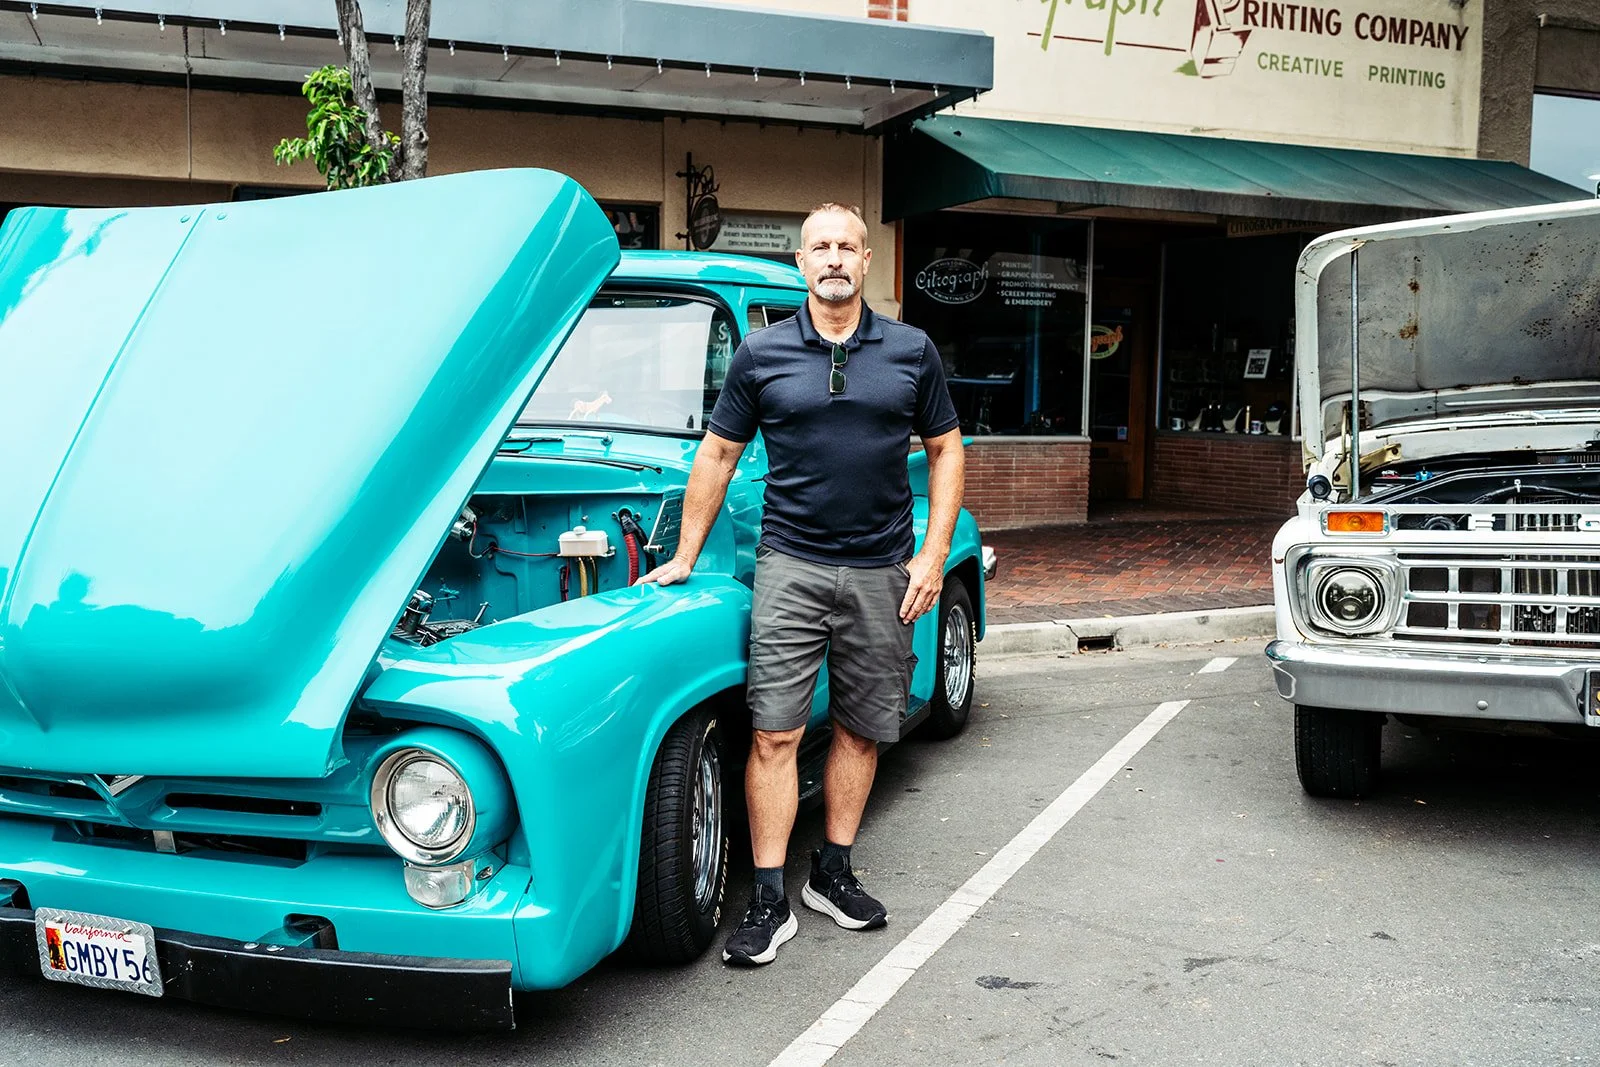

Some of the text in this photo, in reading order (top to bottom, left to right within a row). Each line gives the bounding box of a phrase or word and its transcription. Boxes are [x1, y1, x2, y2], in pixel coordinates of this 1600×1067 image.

[1354, 12, 1470, 51] COMPANY
[1257, 52, 1446, 90] CREATIVE PRINTING
[915, 260, 989, 293] Citrograph
[1001, 270, 1055, 280] GRAPHIC DESIGN
[1001, 280, 1048, 289] PROMOTIONAL
[1000, 290, 1057, 299] SCREEN PRINTING
[1011, 298, 1053, 307] EMBROIDERY
[64, 922, 132, 943] California
